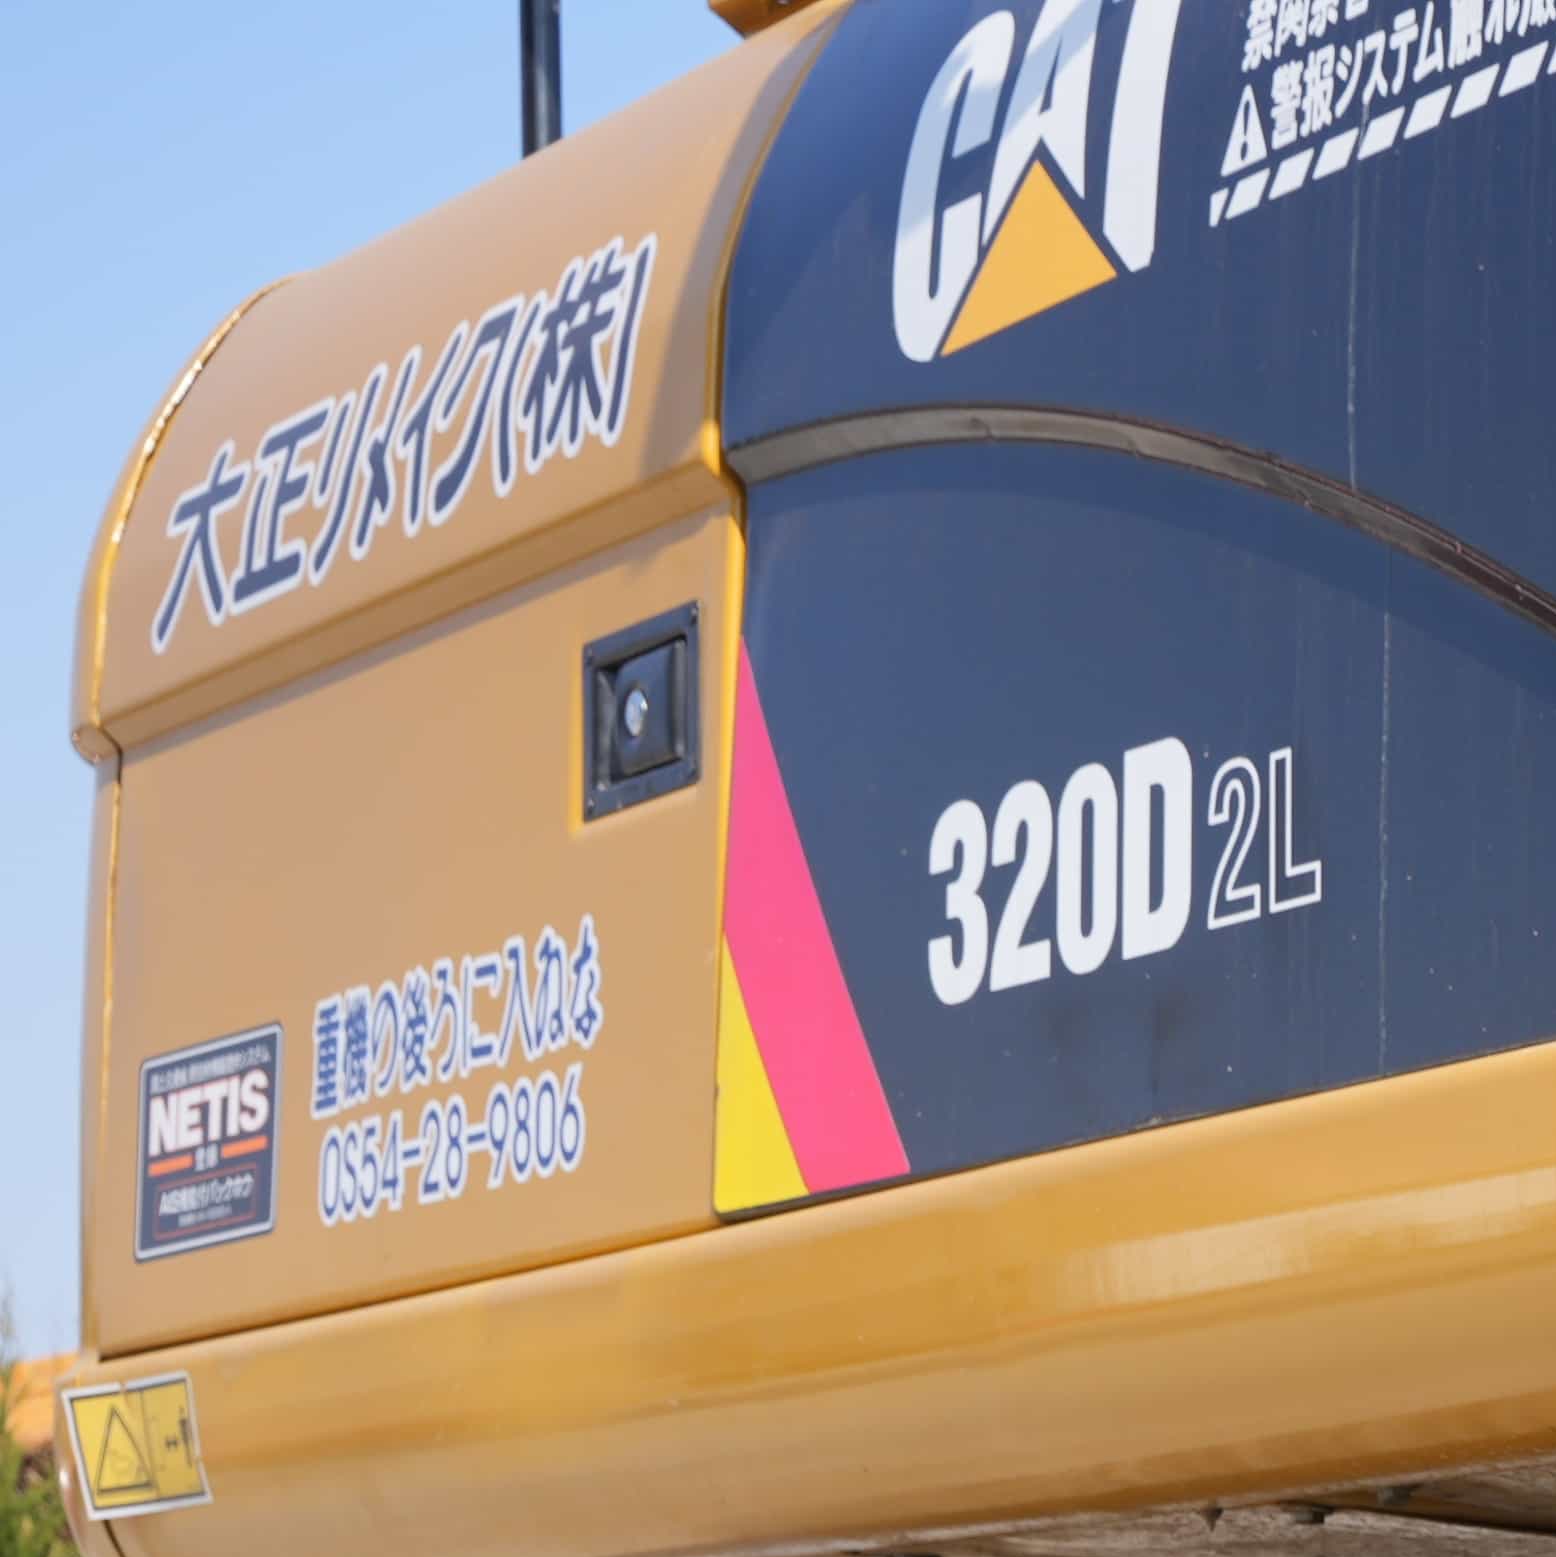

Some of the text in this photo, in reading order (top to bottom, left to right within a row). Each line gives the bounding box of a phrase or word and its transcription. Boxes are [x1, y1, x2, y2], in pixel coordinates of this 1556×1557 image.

[892, 0, 1182, 364] CAT
[928, 736, 1322, 1005] 320D 2L
[148, 1069, 270, 1157] NETIS
